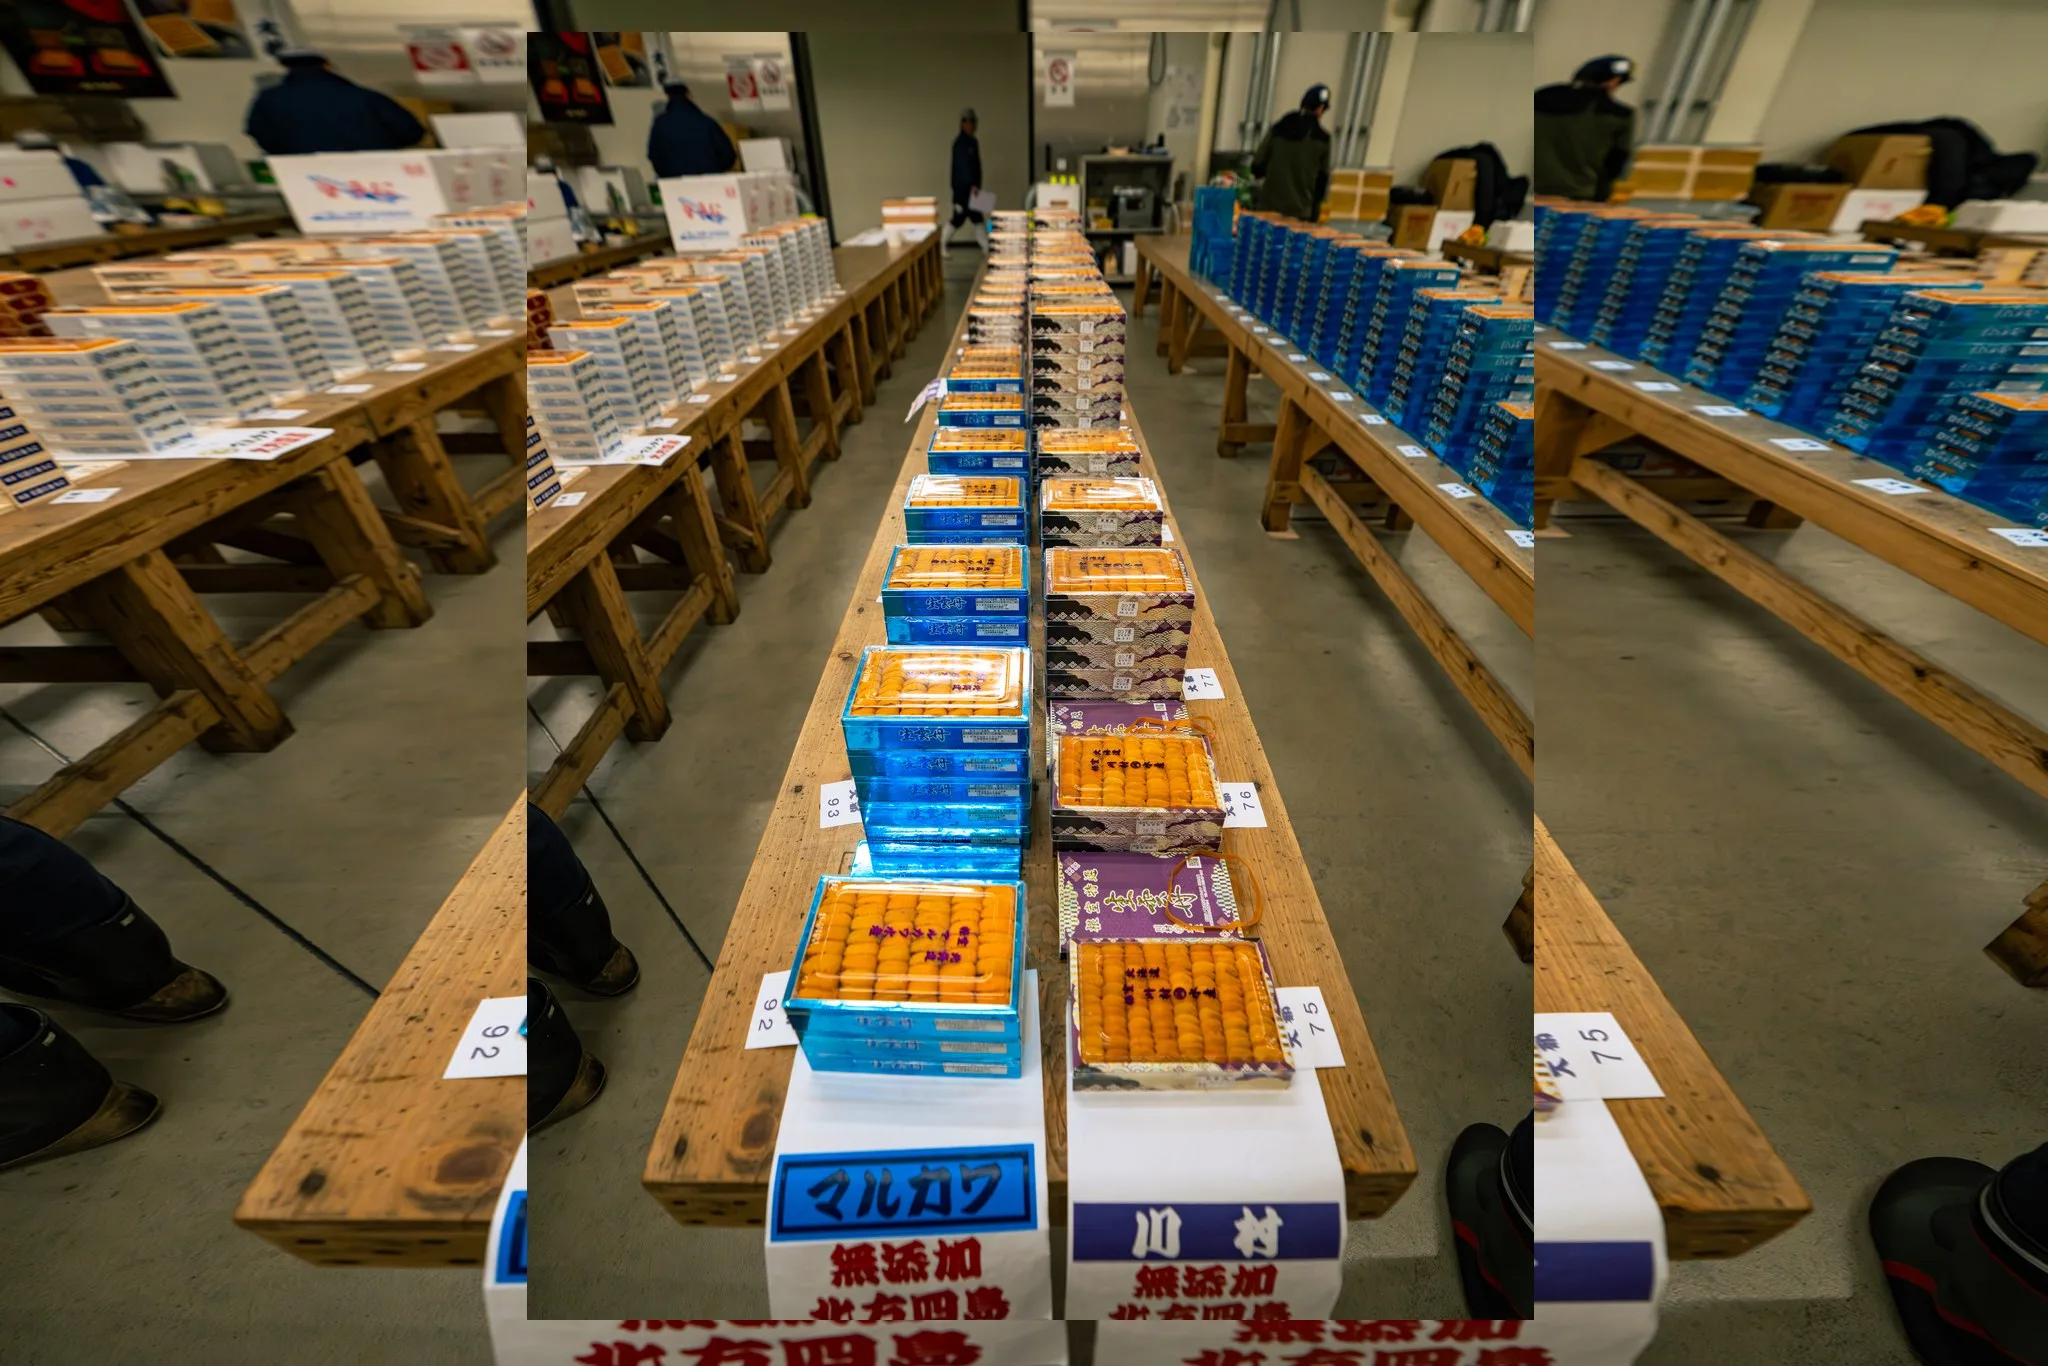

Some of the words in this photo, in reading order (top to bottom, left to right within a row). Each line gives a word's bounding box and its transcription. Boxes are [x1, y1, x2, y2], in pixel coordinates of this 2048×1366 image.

[1200, 674, 1214, 688] 77
[899, 726, 951, 743] 生雲丹
[827, 797, 840, 818] 93
[1239, 791, 1255, 811] 76
[1103, 884, 1197, 918] 生雲丹
[758, 998, 778, 1032] 92
[1302, 1002, 1325, 1036] 75
[470, 1023, 510, 1060] 92
[1577, 1028, 1624, 1065] 75
[806, 1162, 1002, 1222] マルカワ
[1131, 1205, 1283, 1259] 川村
[829, 1236, 982, 1288] 無添加
[1133, 1263, 1279, 1300] 無添加
